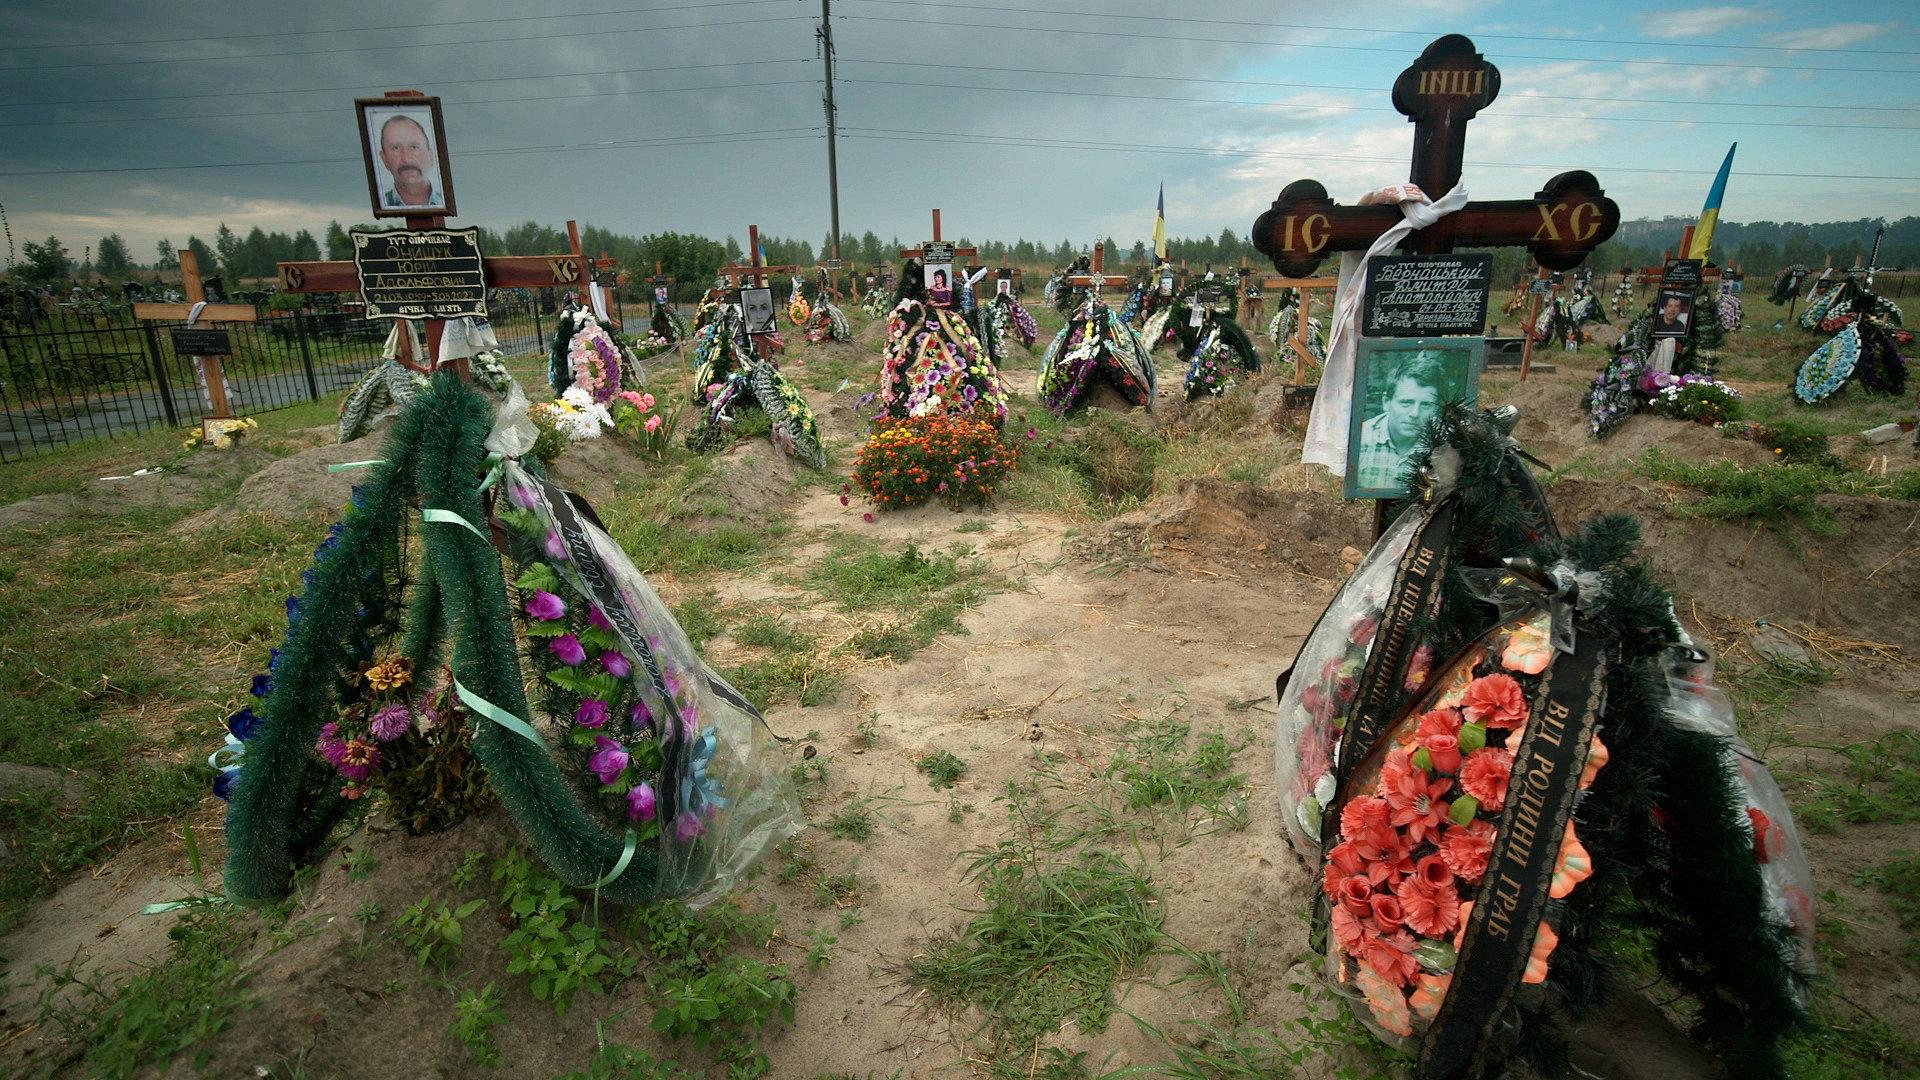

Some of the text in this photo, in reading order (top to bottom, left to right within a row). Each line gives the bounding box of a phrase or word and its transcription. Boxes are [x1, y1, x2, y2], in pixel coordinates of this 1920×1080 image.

[1408, 546, 1434, 577] ВІД
[1534, 698, 1569, 747] ВІД
[1505, 751, 1554, 868] РОДИНИ
